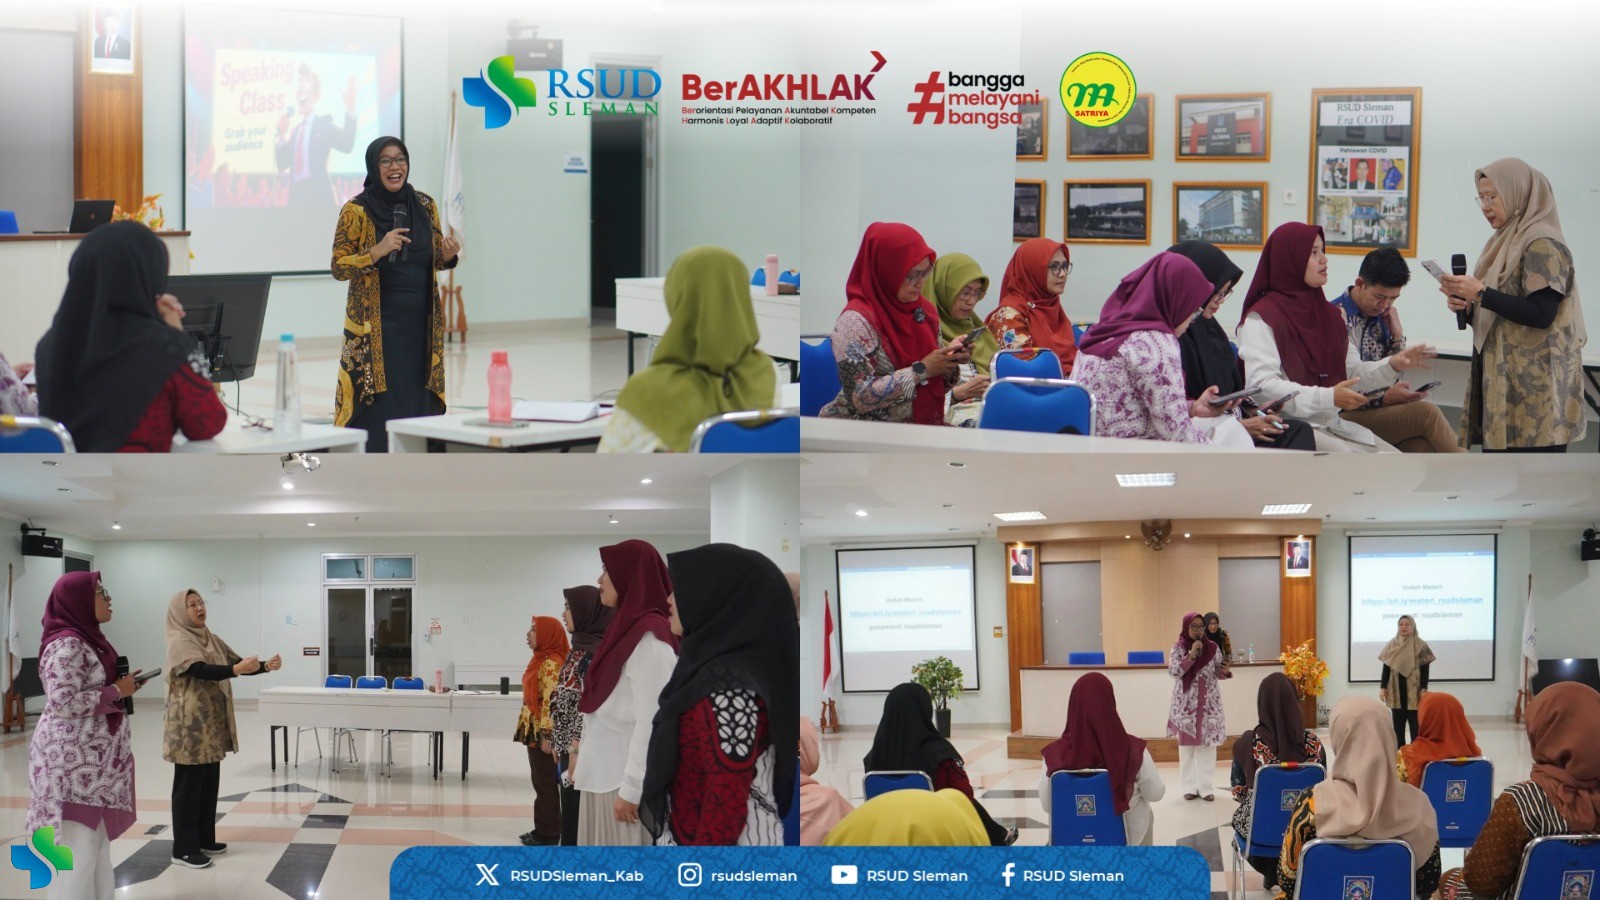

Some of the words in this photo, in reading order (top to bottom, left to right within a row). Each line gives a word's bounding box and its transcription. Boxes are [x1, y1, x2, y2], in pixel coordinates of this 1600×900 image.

[220, 60, 293, 91] Speaking
[240, 90, 285, 115] Class
[1337, 103, 1361, 112] RSUD
[1363, 102, 1394, 111] Sleman
[1337, 115, 1354, 125] Era
[1356, 114, 1394, 125] COVID
[225, 127, 245, 139] Grab
[248, 127, 266, 139] your
[225, 140, 263, 152] audience
